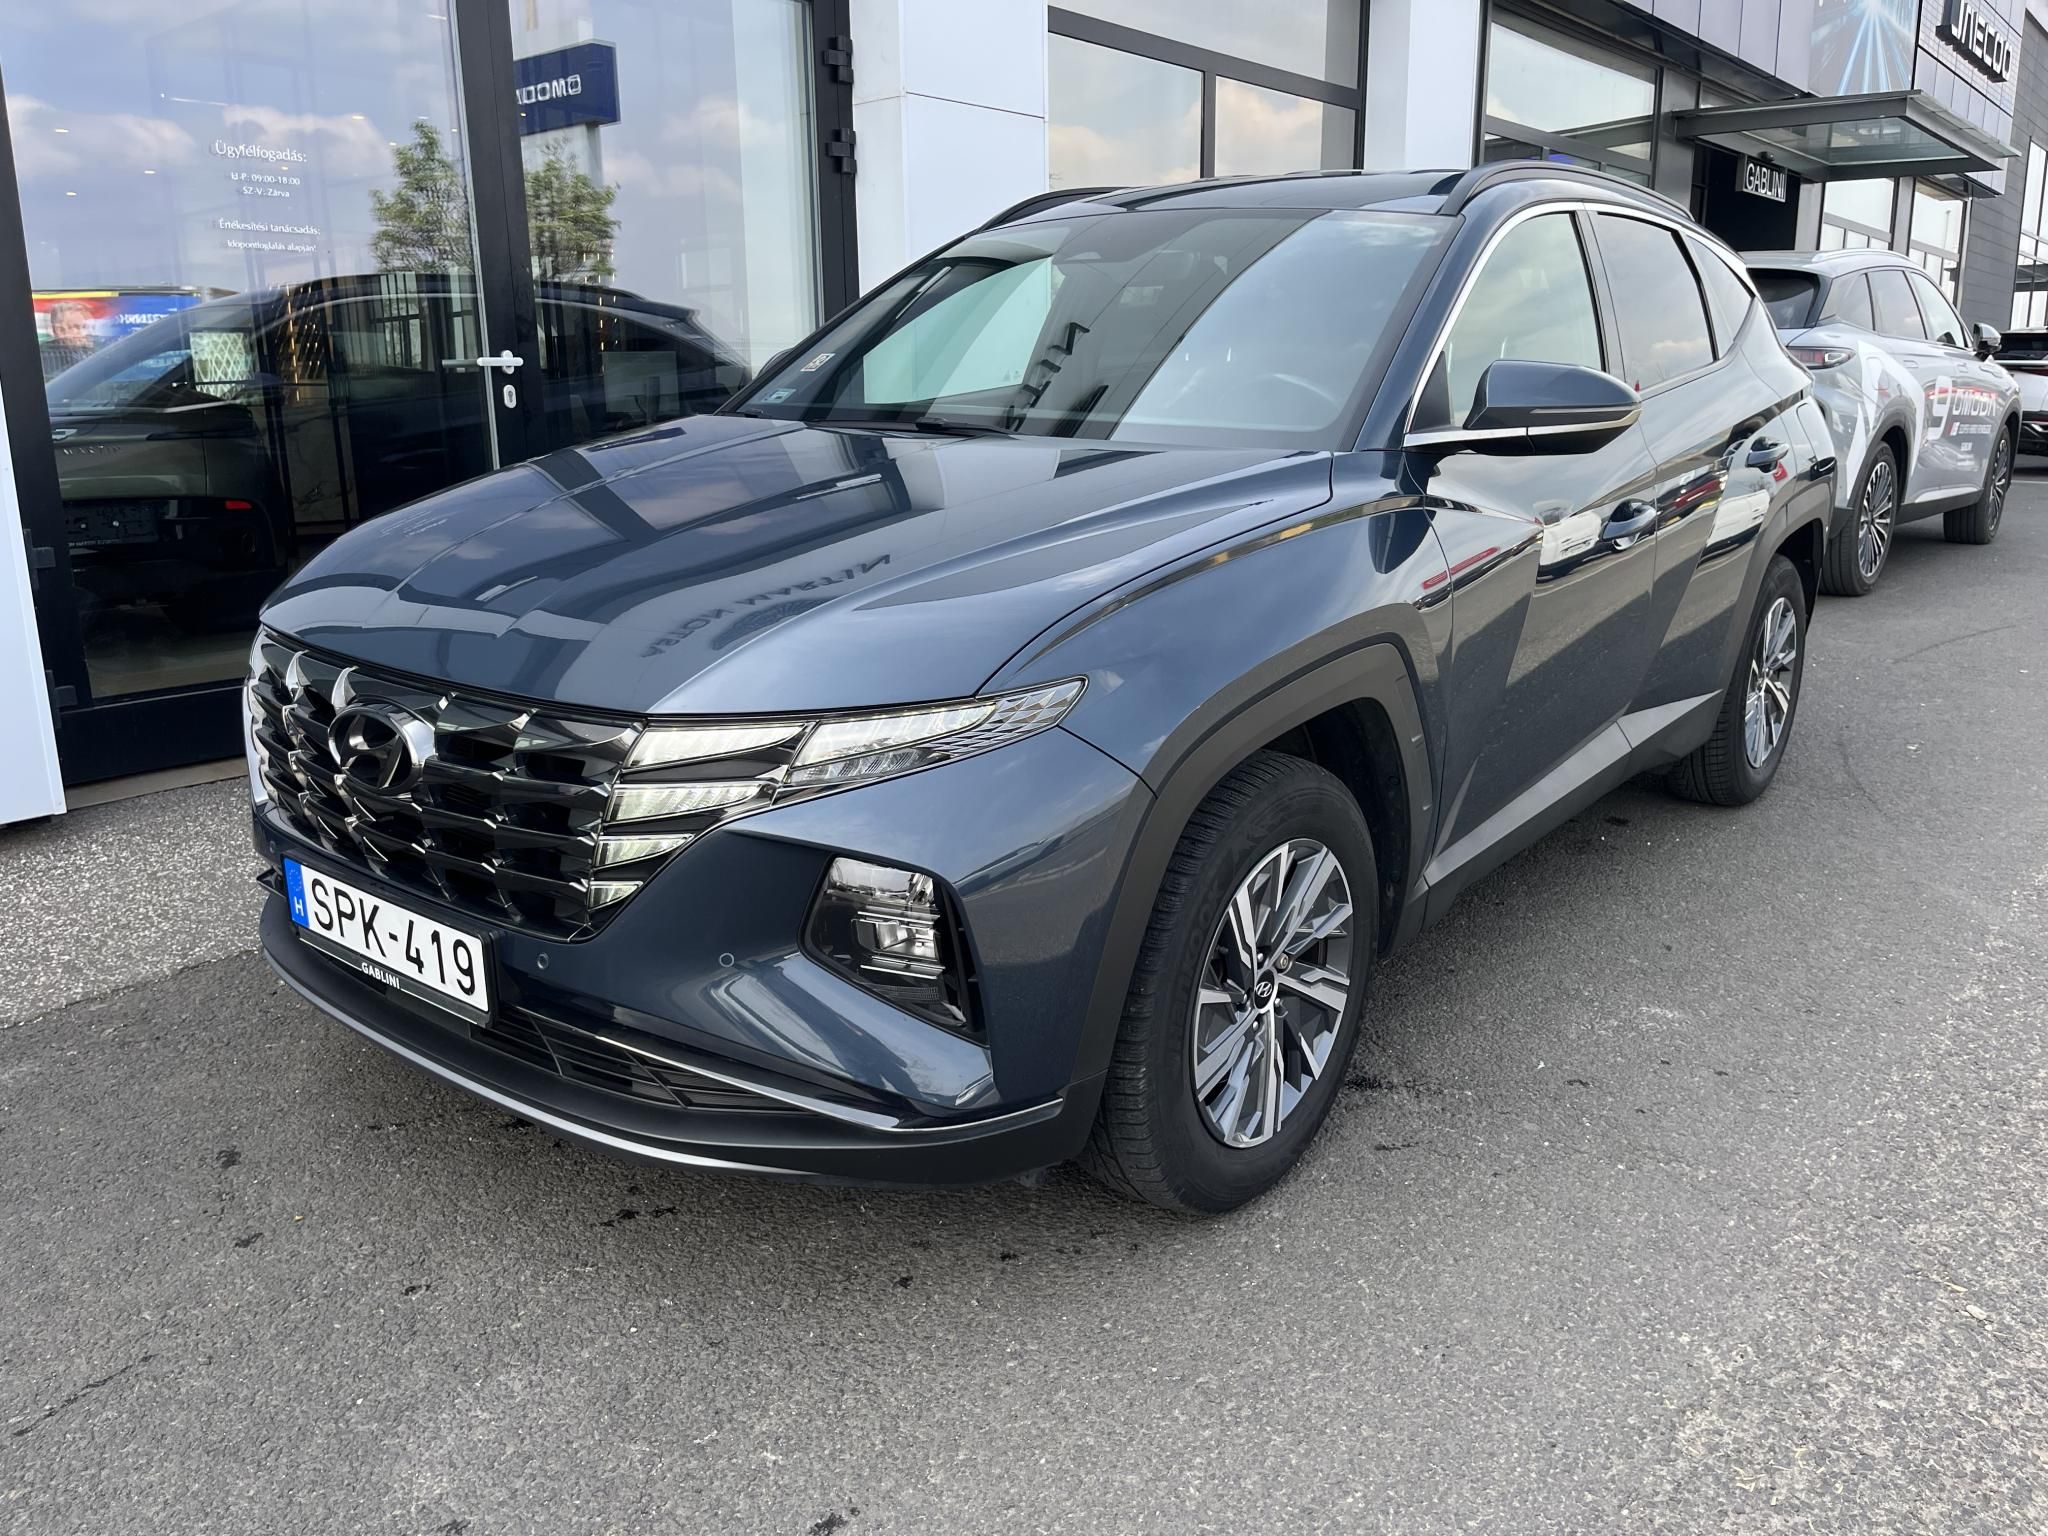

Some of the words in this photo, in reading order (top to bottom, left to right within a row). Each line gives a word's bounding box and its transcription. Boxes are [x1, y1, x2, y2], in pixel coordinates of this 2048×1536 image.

[214, 139, 308, 163] Ügyfélfogadás:
[251, 173, 301, 185] 09:00-18:00
[1746, 163, 1785, 198] GABLINI
[267, 187, 290, 198] Zárva
[270, 223, 321, 236] tanácsadás:
[1926, 376, 1952, 440] 9
[1952, 391, 1998, 416] OMODA
[293, 895, 305, 917] H
[311, 877, 476, 996] SPK-419
[361, 961, 401, 990] GABLINI
